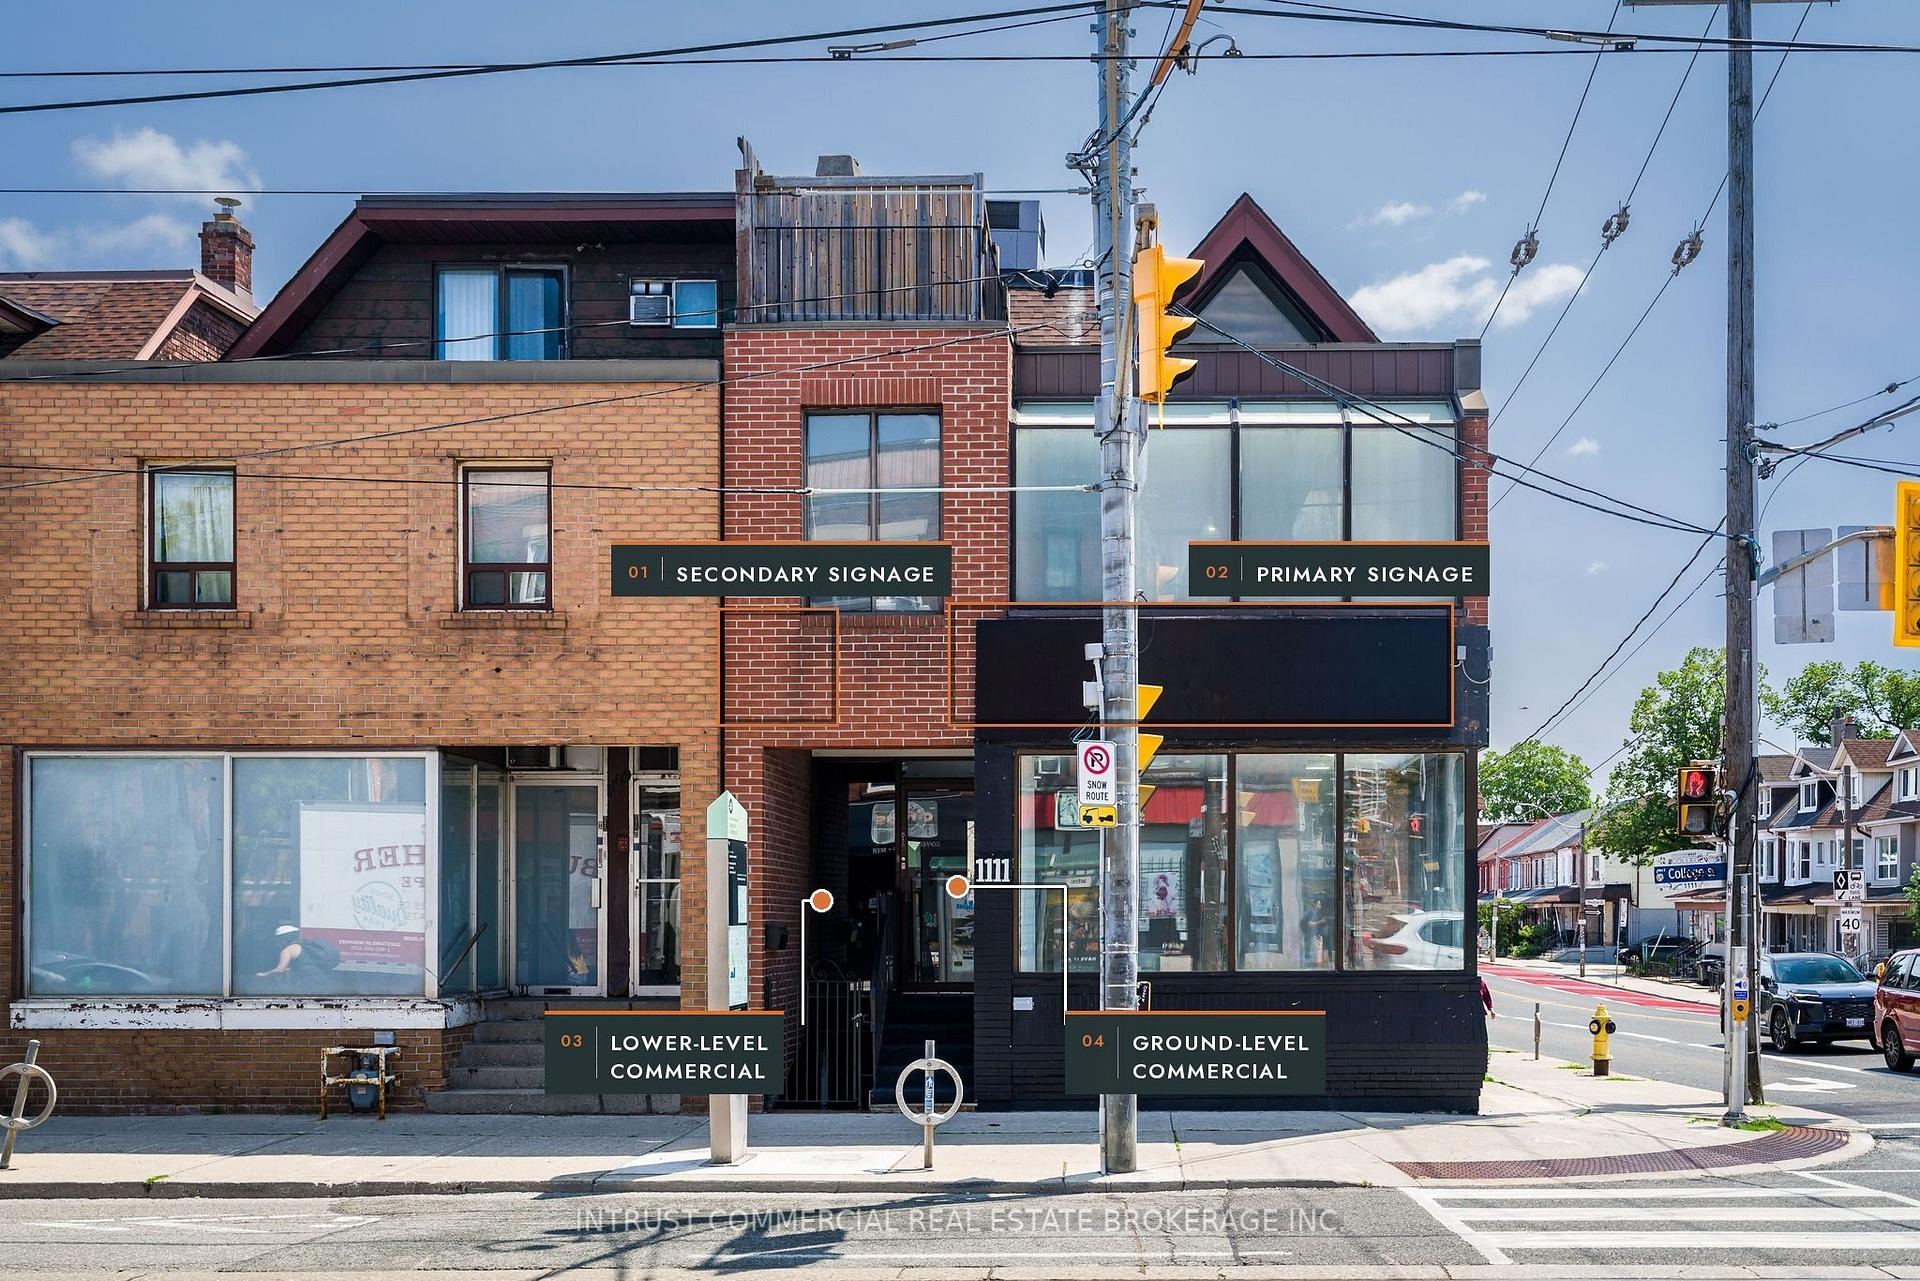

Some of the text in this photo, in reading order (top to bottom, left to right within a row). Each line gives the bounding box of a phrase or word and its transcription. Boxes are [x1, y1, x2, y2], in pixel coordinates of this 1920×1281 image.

[1087, 780, 1107, 790] SNOW
[1085, 791, 1109, 801] ROUTE
[975, 858, 1011, 883] 1111
[1841, 918, 1860, 930] 40
